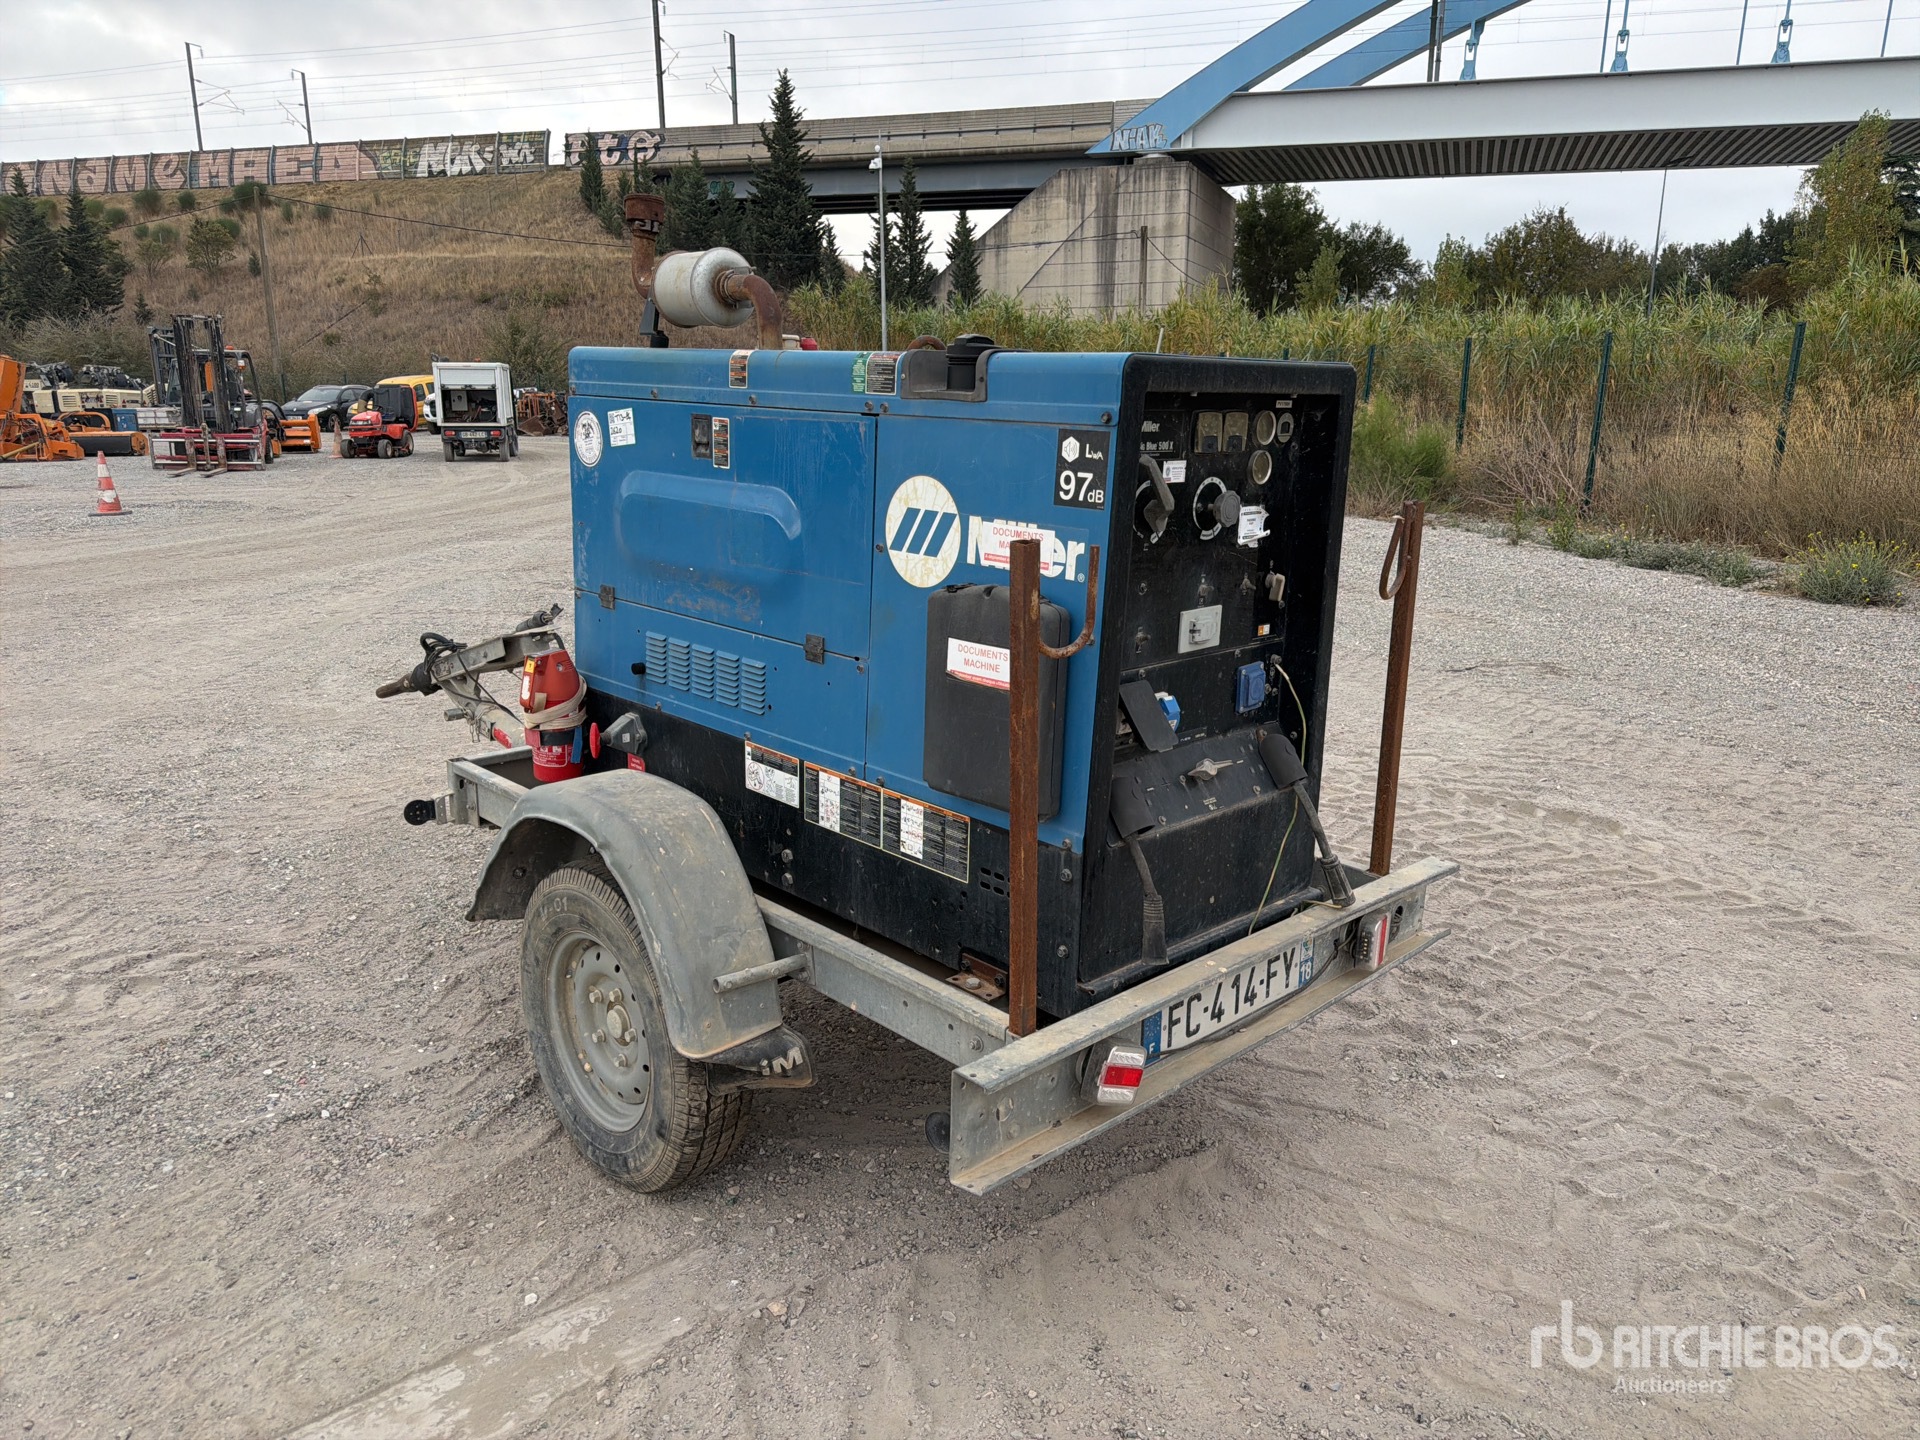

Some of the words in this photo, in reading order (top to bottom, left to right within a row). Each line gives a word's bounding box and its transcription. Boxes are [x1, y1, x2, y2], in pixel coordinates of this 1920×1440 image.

[1059, 470, 1093, 501] 97
[1087, 489, 1104, 503] dB
[992, 526, 1045, 542] DOCUMENTS
[957, 643, 1009, 662] DOCUMENTS
[963, 657, 1001, 673] MACHINE
[1166, 947, 1296, 1048] FC-414-FY
[1149, 1042, 1156, 1055] F
